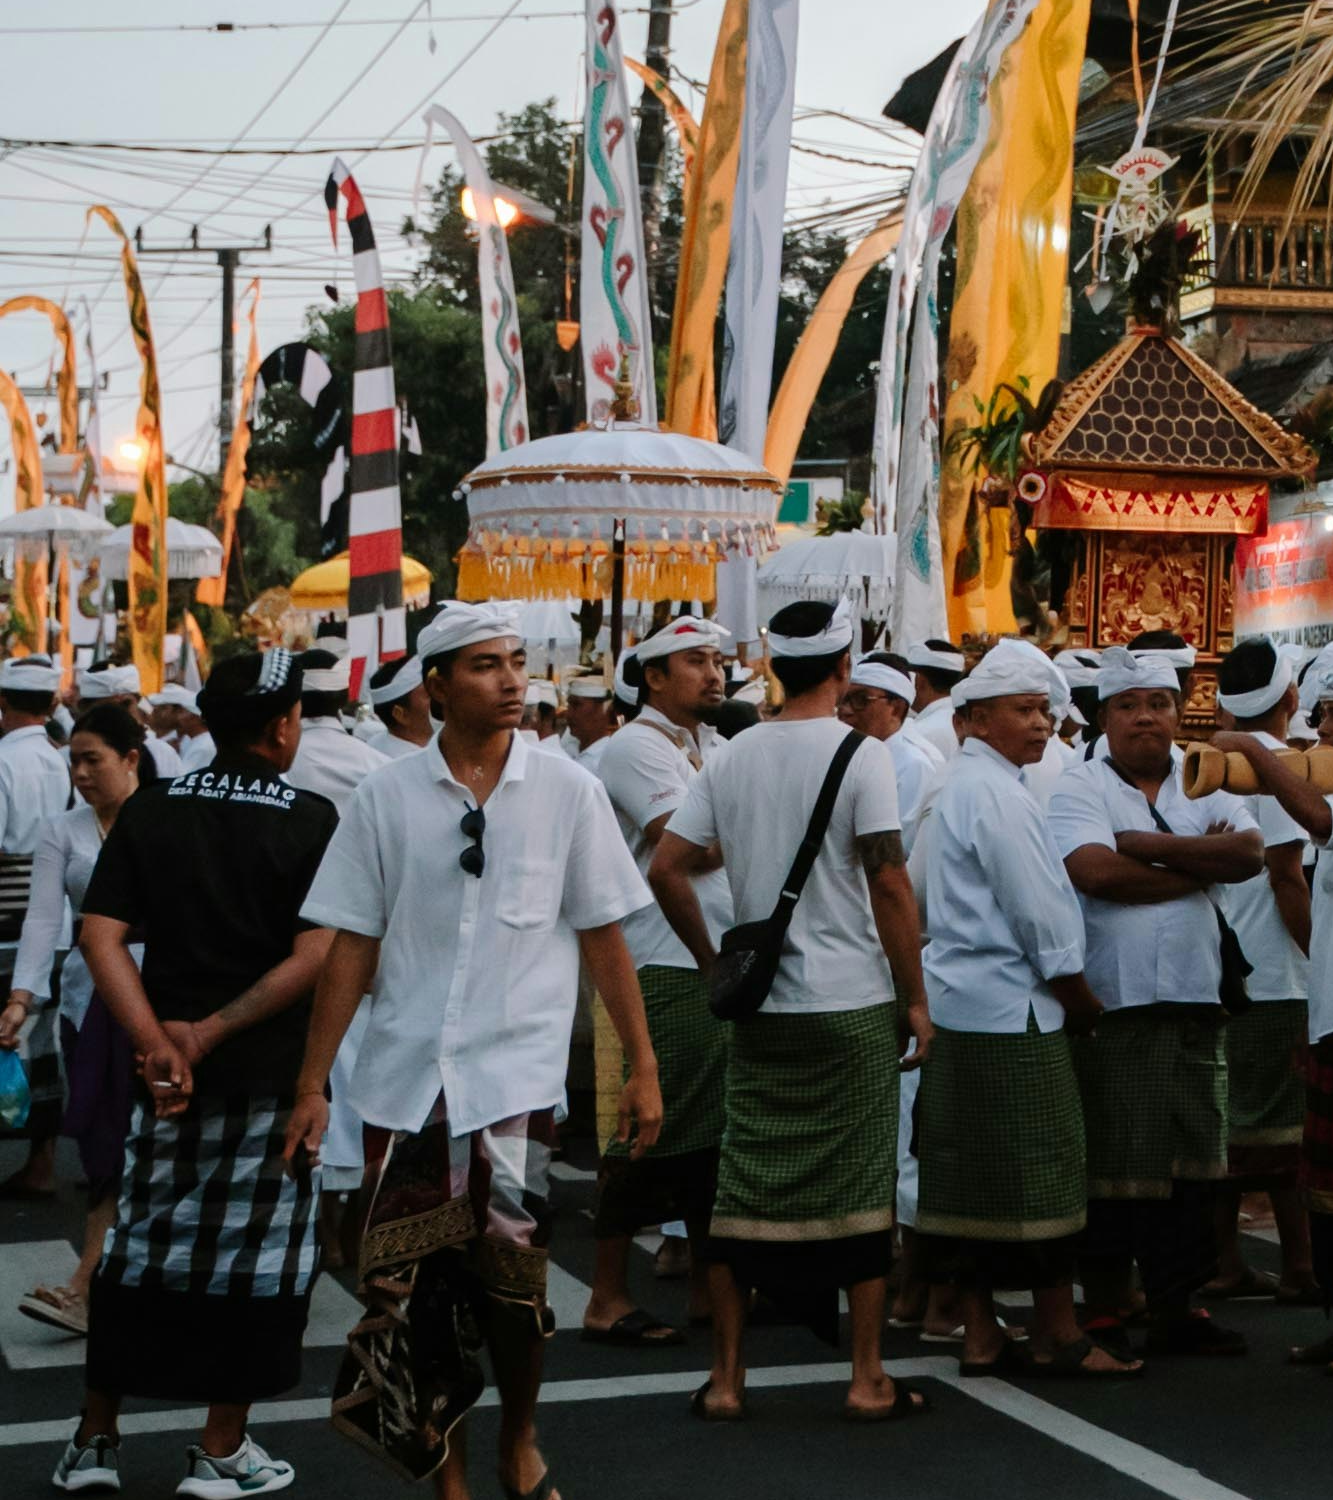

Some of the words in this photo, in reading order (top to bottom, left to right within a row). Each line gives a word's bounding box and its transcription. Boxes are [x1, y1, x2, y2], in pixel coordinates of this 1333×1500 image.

[168, 786, 193, 796] DESA
[197, 787, 226, 800] ADAT
[172, 772, 296, 800] PECALANG
